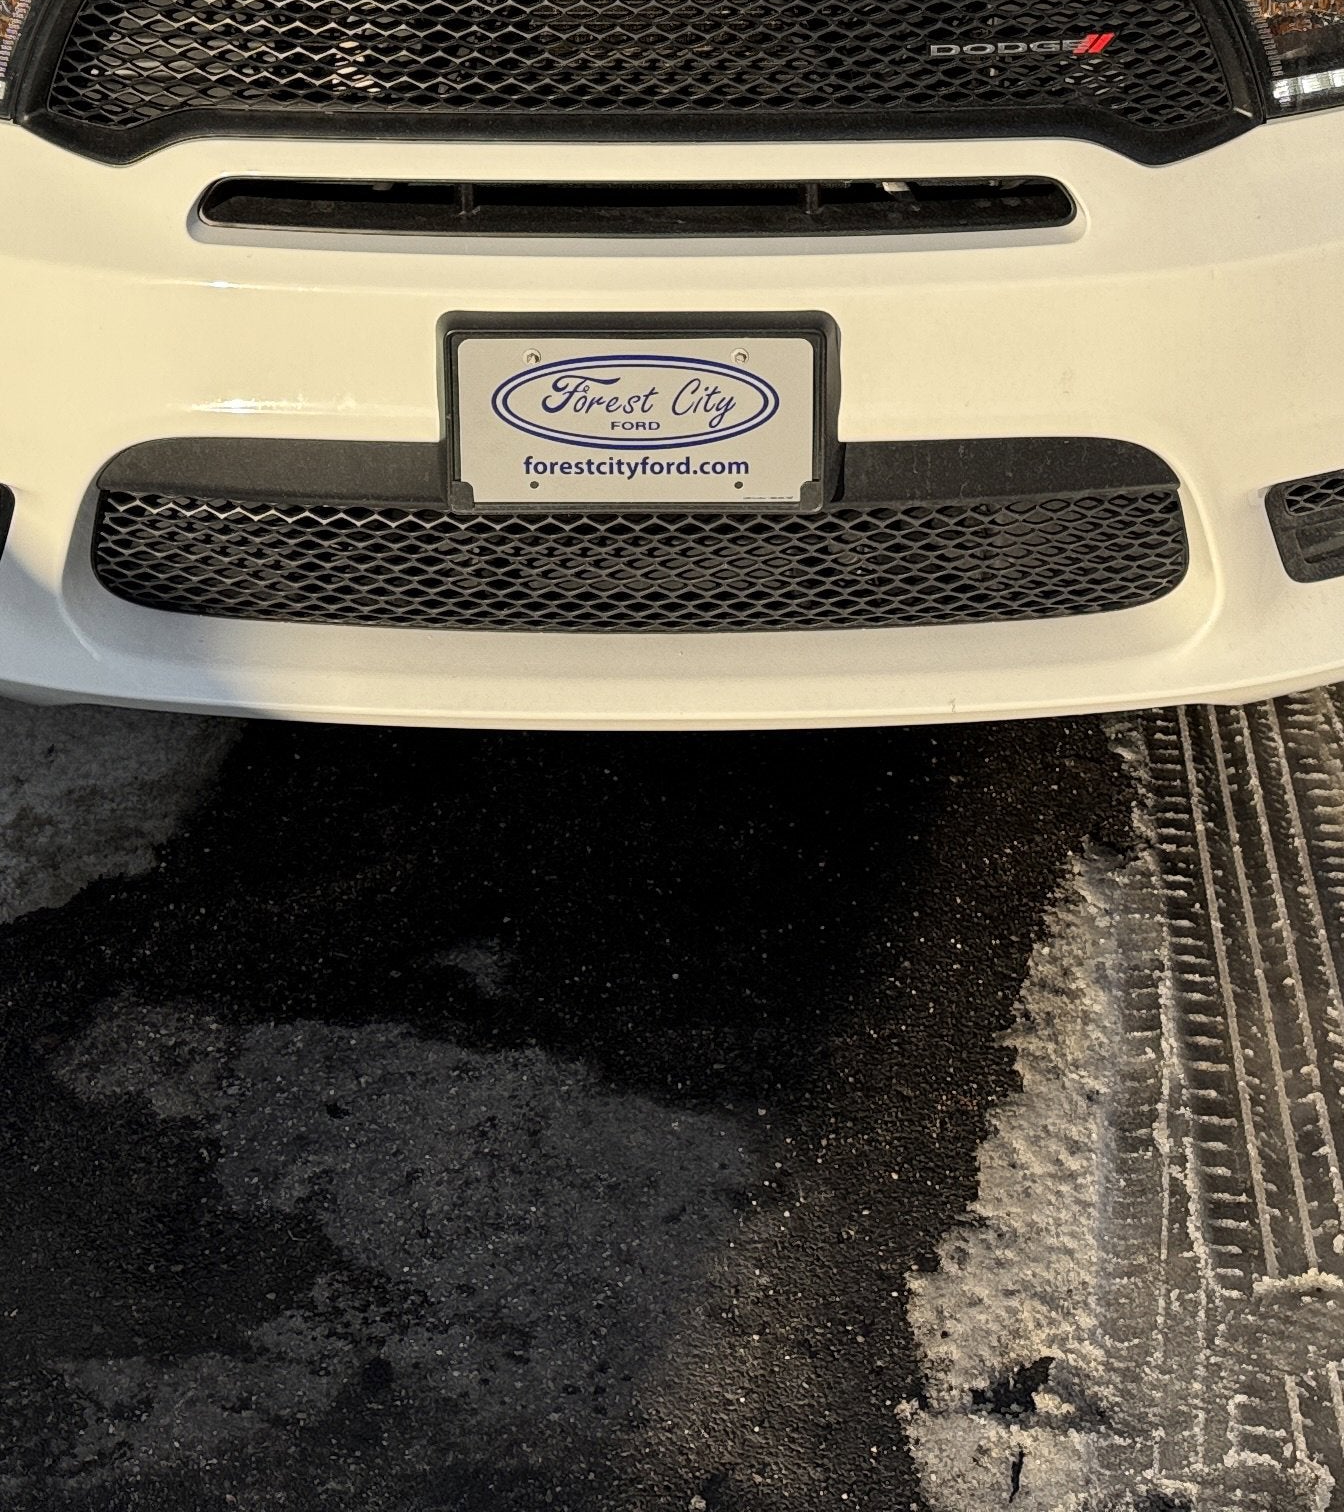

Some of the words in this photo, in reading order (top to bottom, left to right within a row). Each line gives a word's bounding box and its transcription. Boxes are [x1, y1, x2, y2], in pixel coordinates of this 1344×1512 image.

[930, 39, 1088, 57] DODGE
[541, 374, 660, 414] Forest
[671, 377, 736, 429] City
[610, 421, 661, 431] FORD
[523, 455, 750, 480] forestcityford.com
